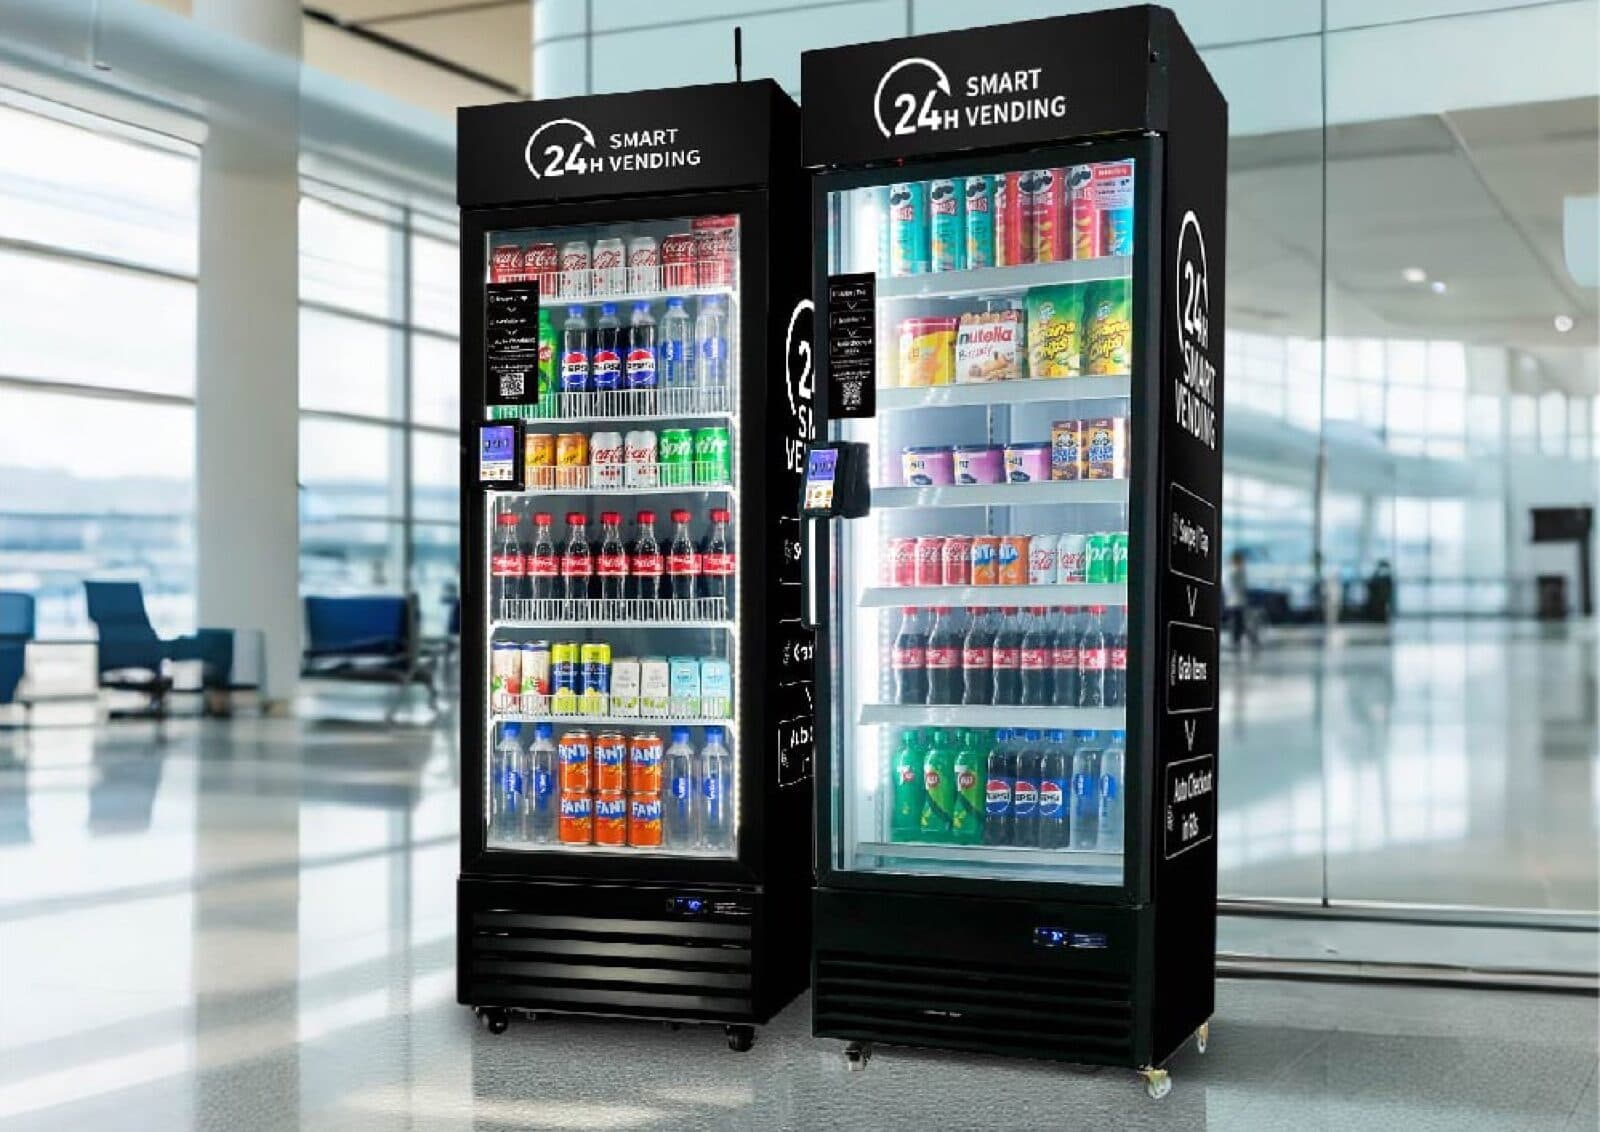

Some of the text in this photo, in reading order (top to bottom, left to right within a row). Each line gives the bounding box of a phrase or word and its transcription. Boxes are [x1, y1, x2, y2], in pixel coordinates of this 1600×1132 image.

[966, 67, 1042, 97] SMART
[964, 95, 1067, 127] VENDING
[609, 128, 679, 150] SMART
[608, 149, 701, 172] VENDING
[959, 326, 1013, 345] nutella
[1183, 340, 1216, 412] SMART
[1174, 377, 1216, 452] VENDING
